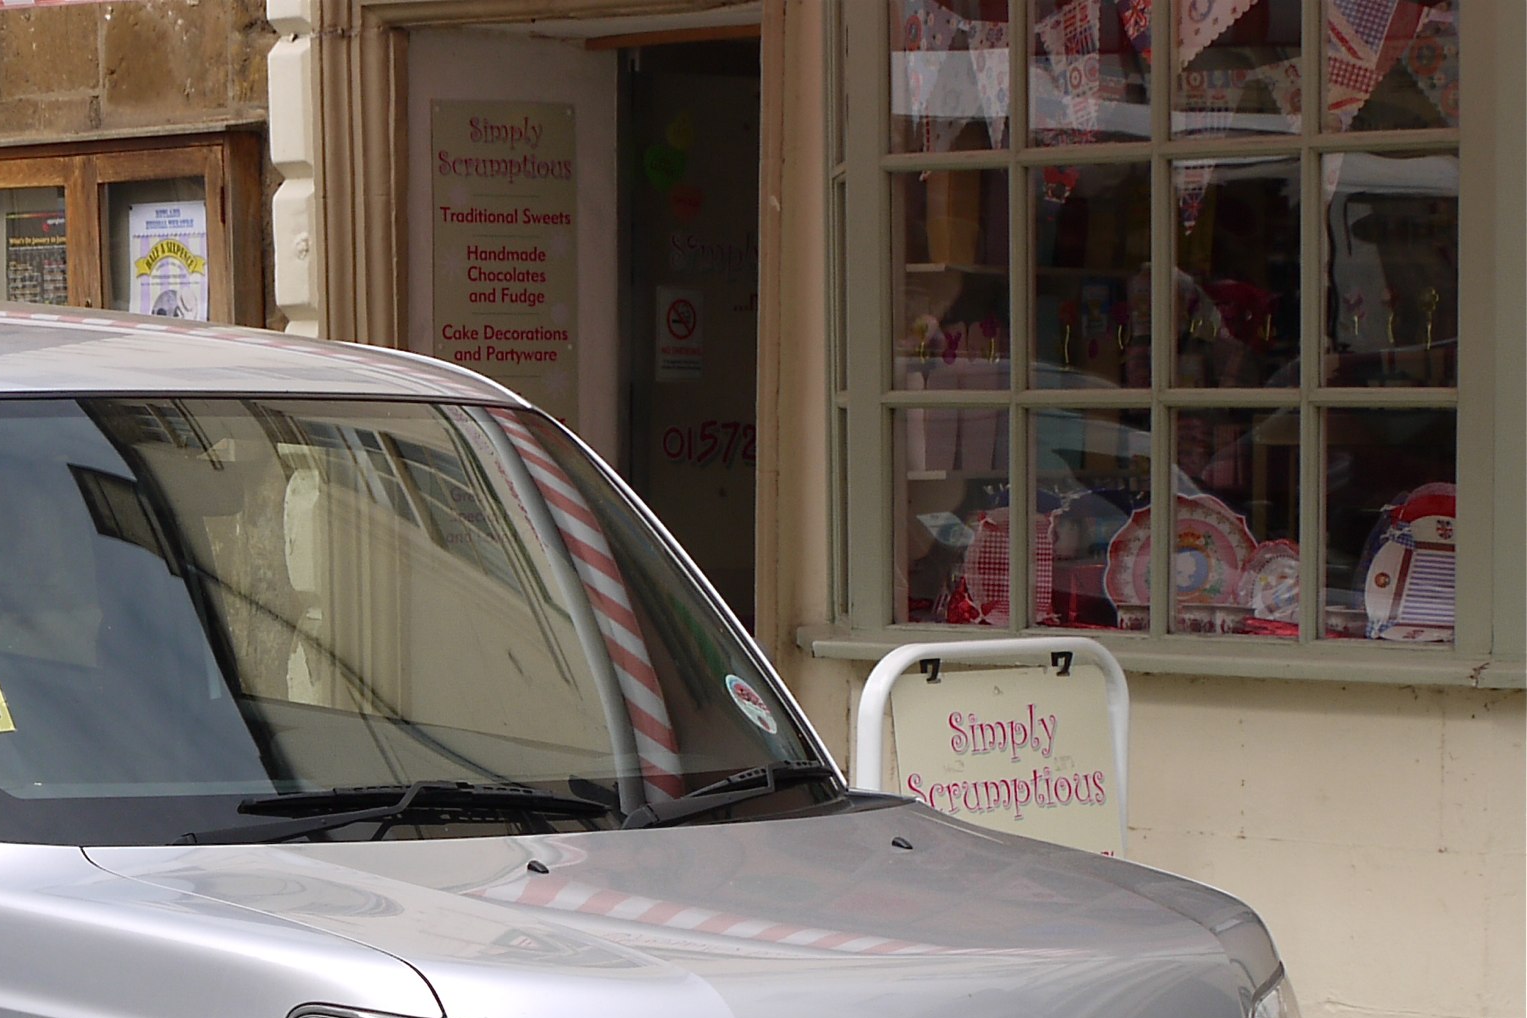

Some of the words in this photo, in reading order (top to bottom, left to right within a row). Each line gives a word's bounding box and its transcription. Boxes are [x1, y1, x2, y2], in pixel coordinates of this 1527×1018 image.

[469, 116, 544, 149] Simply
[438, 150, 573, 184] Scrumptious
[439, 206, 518, 224] Traditional
[522, 208, 571, 225] Sweets
[467, 245, 547, 262] Handmade
[467, 265, 547, 283] Chocolates
[469, 288, 497, 304] and
[501, 287, 545, 307] Fudge
[442, 323, 479, 341] Cake
[484, 325, 569, 341] Decorations
[454, 345, 481, 362] and
[486, 345, 558, 365] Partyware
[663, 419, 756, 464] 01572
[948, 703, 1057, 763] Simply
[907, 766, 1107, 821] Scrumptious
